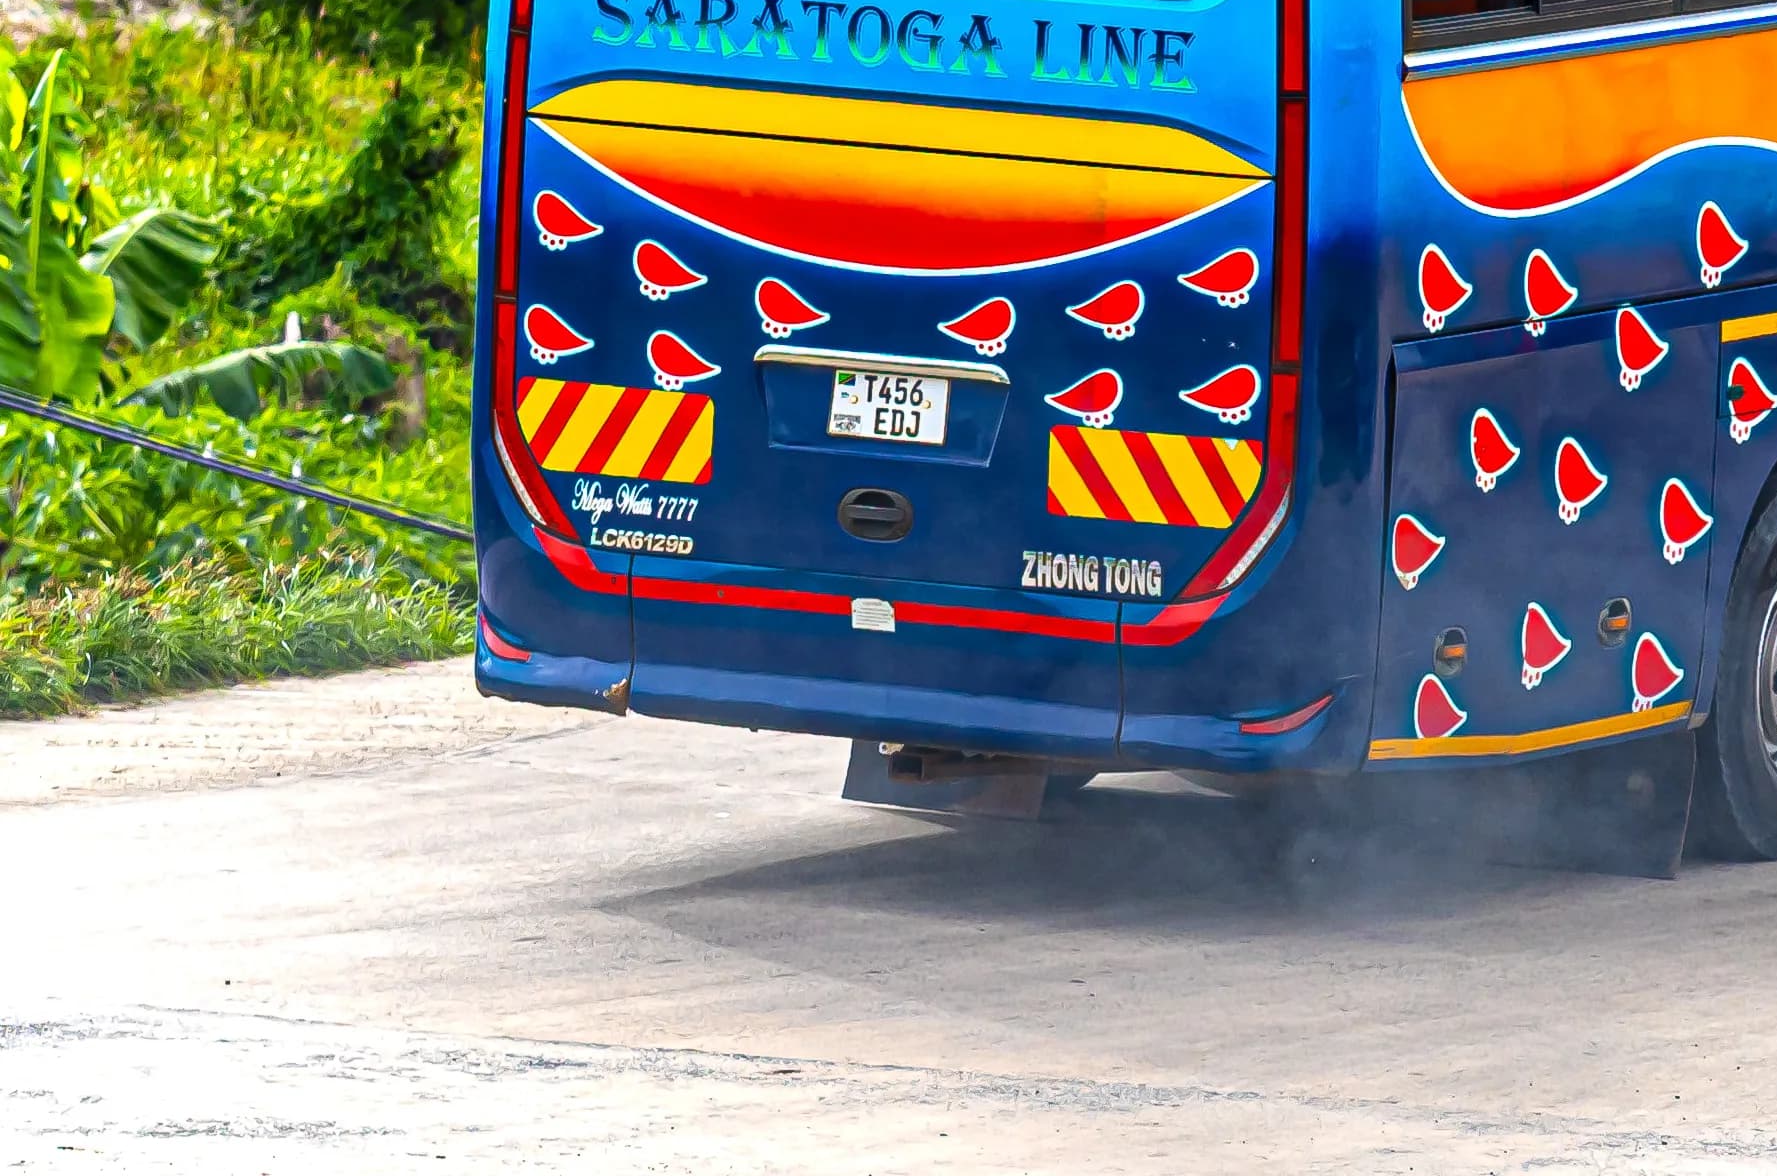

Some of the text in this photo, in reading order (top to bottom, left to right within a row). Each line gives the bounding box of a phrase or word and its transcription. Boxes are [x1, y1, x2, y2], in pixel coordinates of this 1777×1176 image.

[1031, 20, 1197, 94] LINE
[864, 374, 924, 407] T456
[873, 407, 921, 438] EDJ
[657, 495, 699, 522] 7777
[590, 527, 695, 555] LCK6129D
[1021, 550, 1162, 597] ZHONG TONG
